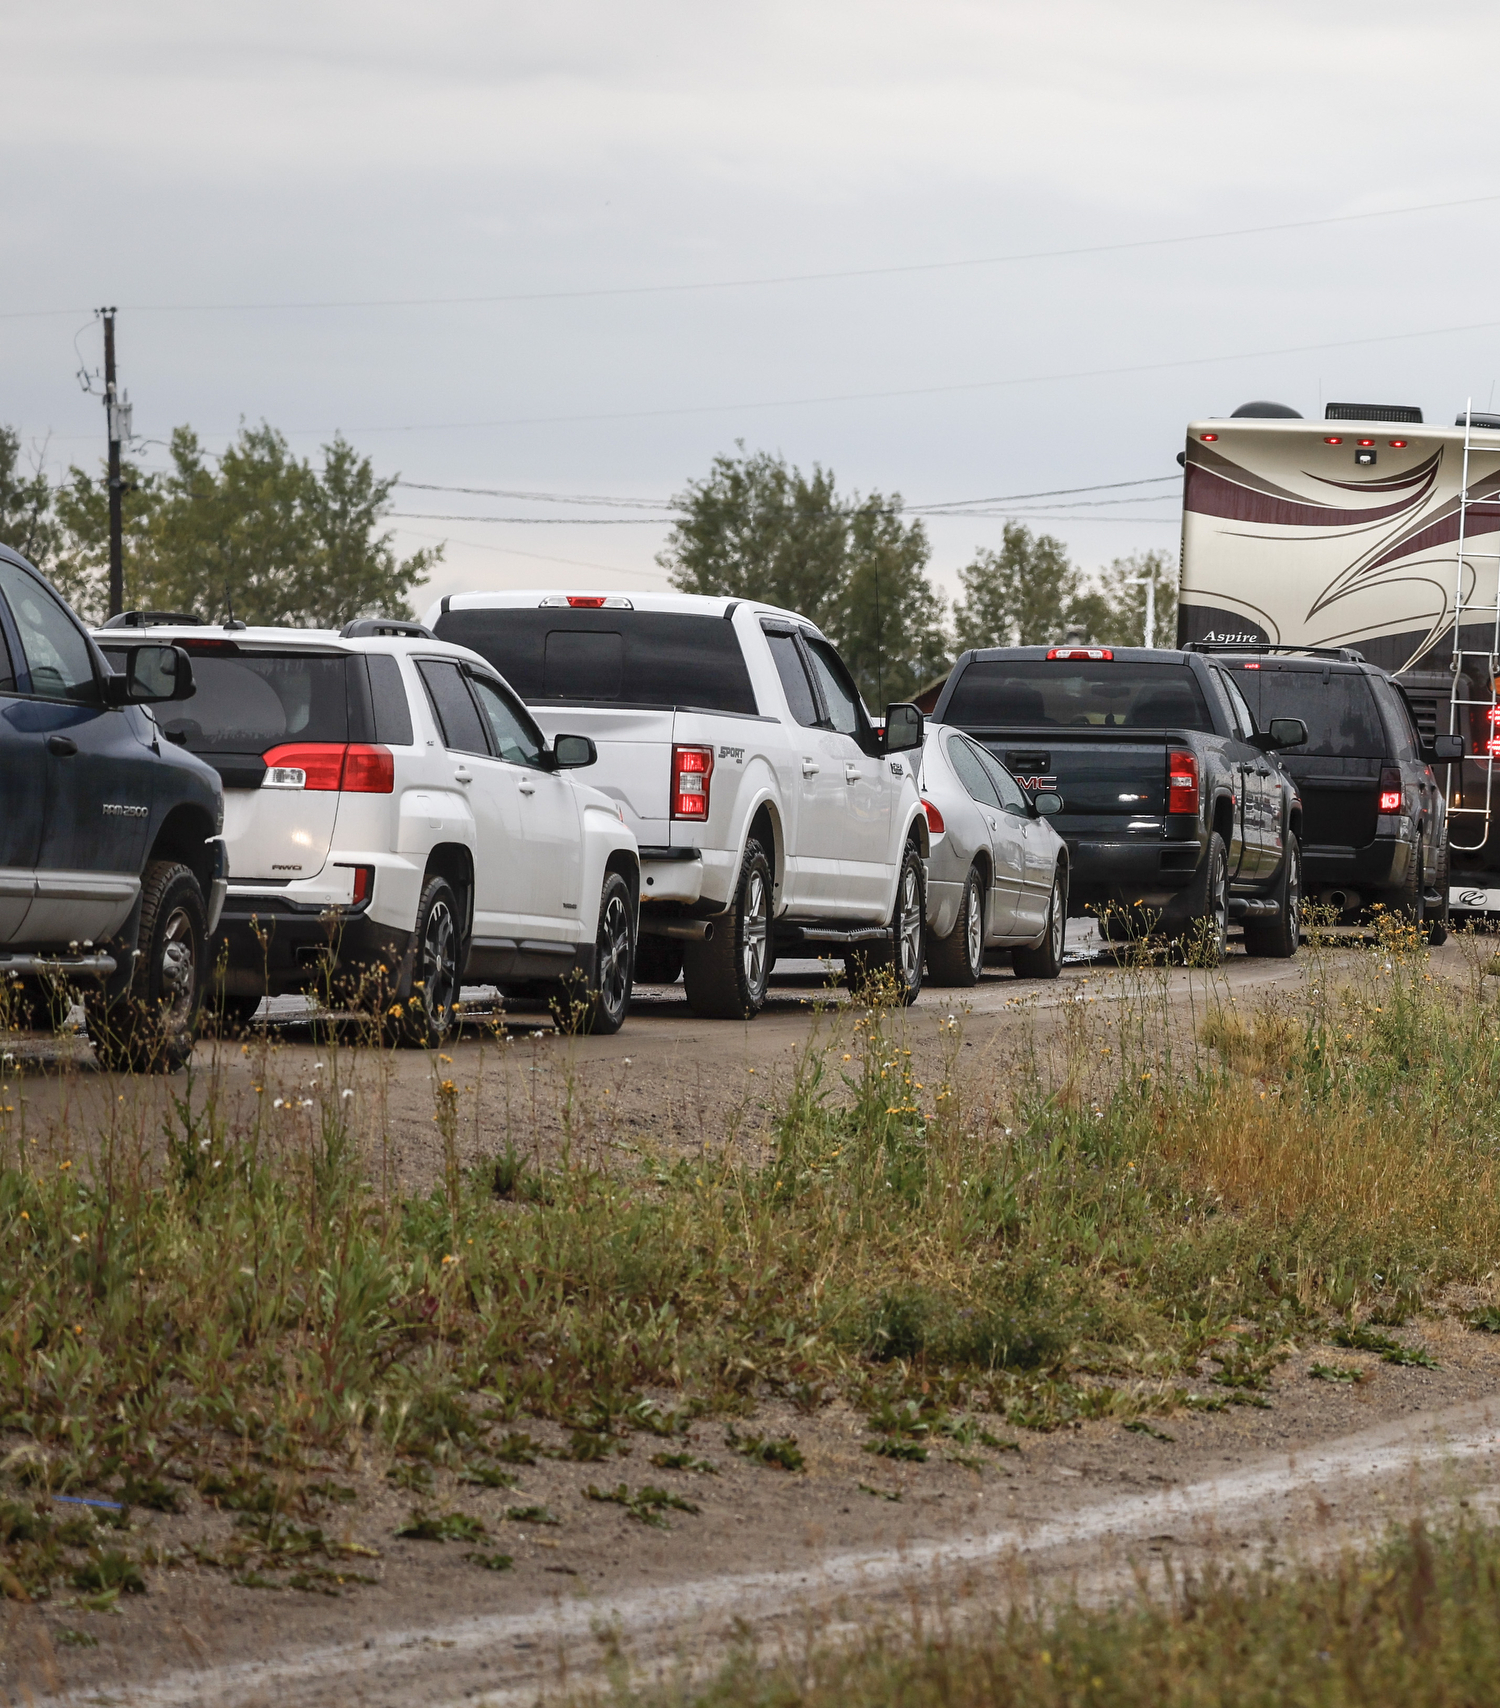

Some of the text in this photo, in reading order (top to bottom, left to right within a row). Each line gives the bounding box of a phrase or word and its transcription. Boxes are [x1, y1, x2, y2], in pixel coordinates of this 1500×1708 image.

[1202, 630, 1258, 645] Aspire
[718, 745, 745, 759] SPORT
[1013, 775, 1058, 790] MC
[102, 803, 149, 818] RAM 2500
